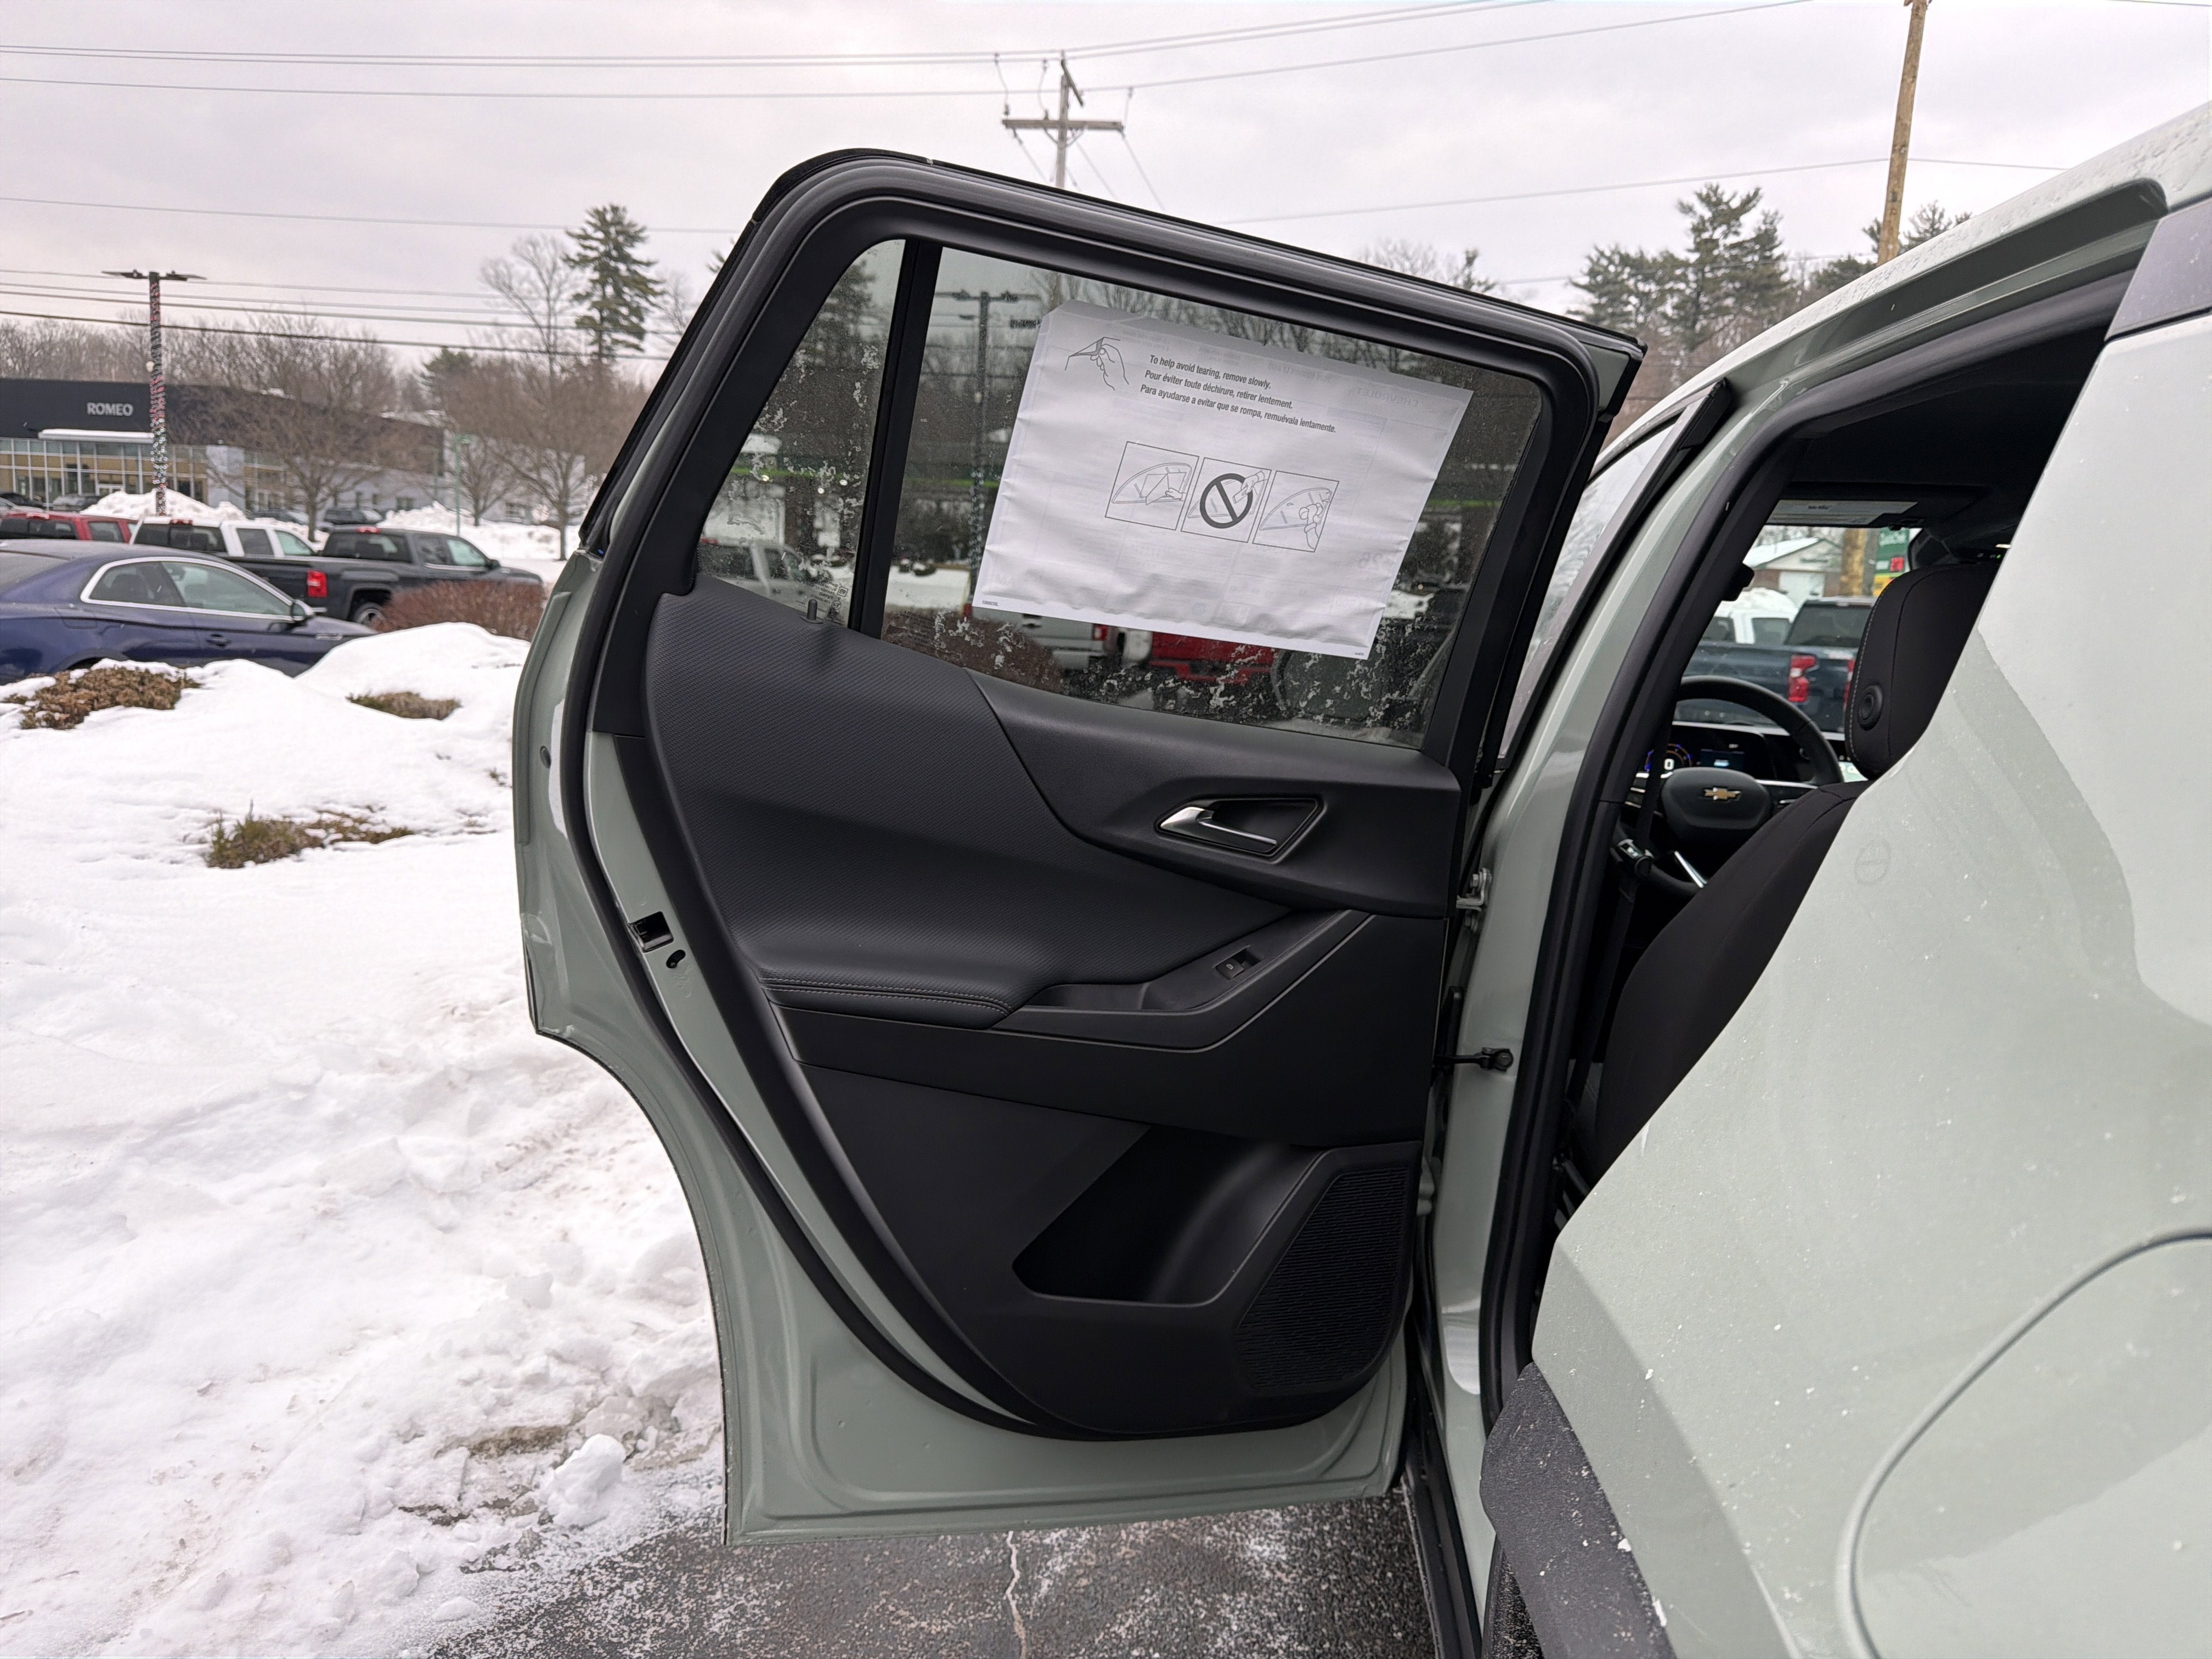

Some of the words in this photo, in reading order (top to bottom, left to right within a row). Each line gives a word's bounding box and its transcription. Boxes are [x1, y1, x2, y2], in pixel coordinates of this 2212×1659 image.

[1144, 370, 1162, 381] Pour
[1162, 373, 1183, 385] éviter
[1184, 379, 1201, 390] toute
[1203, 383, 1235, 398] déchirure,
[1236, 390, 1257, 401] retirer
[1258, 394, 1293, 409] lentement.
[1150, 354, 1158, 364] To
[1159, 357, 1175, 369] help
[1176, 362, 1195, 373] avoid
[1196, 365, 1221, 380] tearing,
[1222, 372, 1246, 383] remove
[1248, 377, 1271, 390] slowly.
[87, 402, 133, 416] ROMEO
[1140, 384, 1156, 396] Para
[1158, 390, 1190, 403] ayudarse
[1197, 398, 1216, 408] evitar
[1216, 402, 1229, 411] que
[1239, 407, 1262, 419] rompa,
[1264, 411, 1299, 426] remuévala
[1299, 418, 1336, 433] lentamente.
